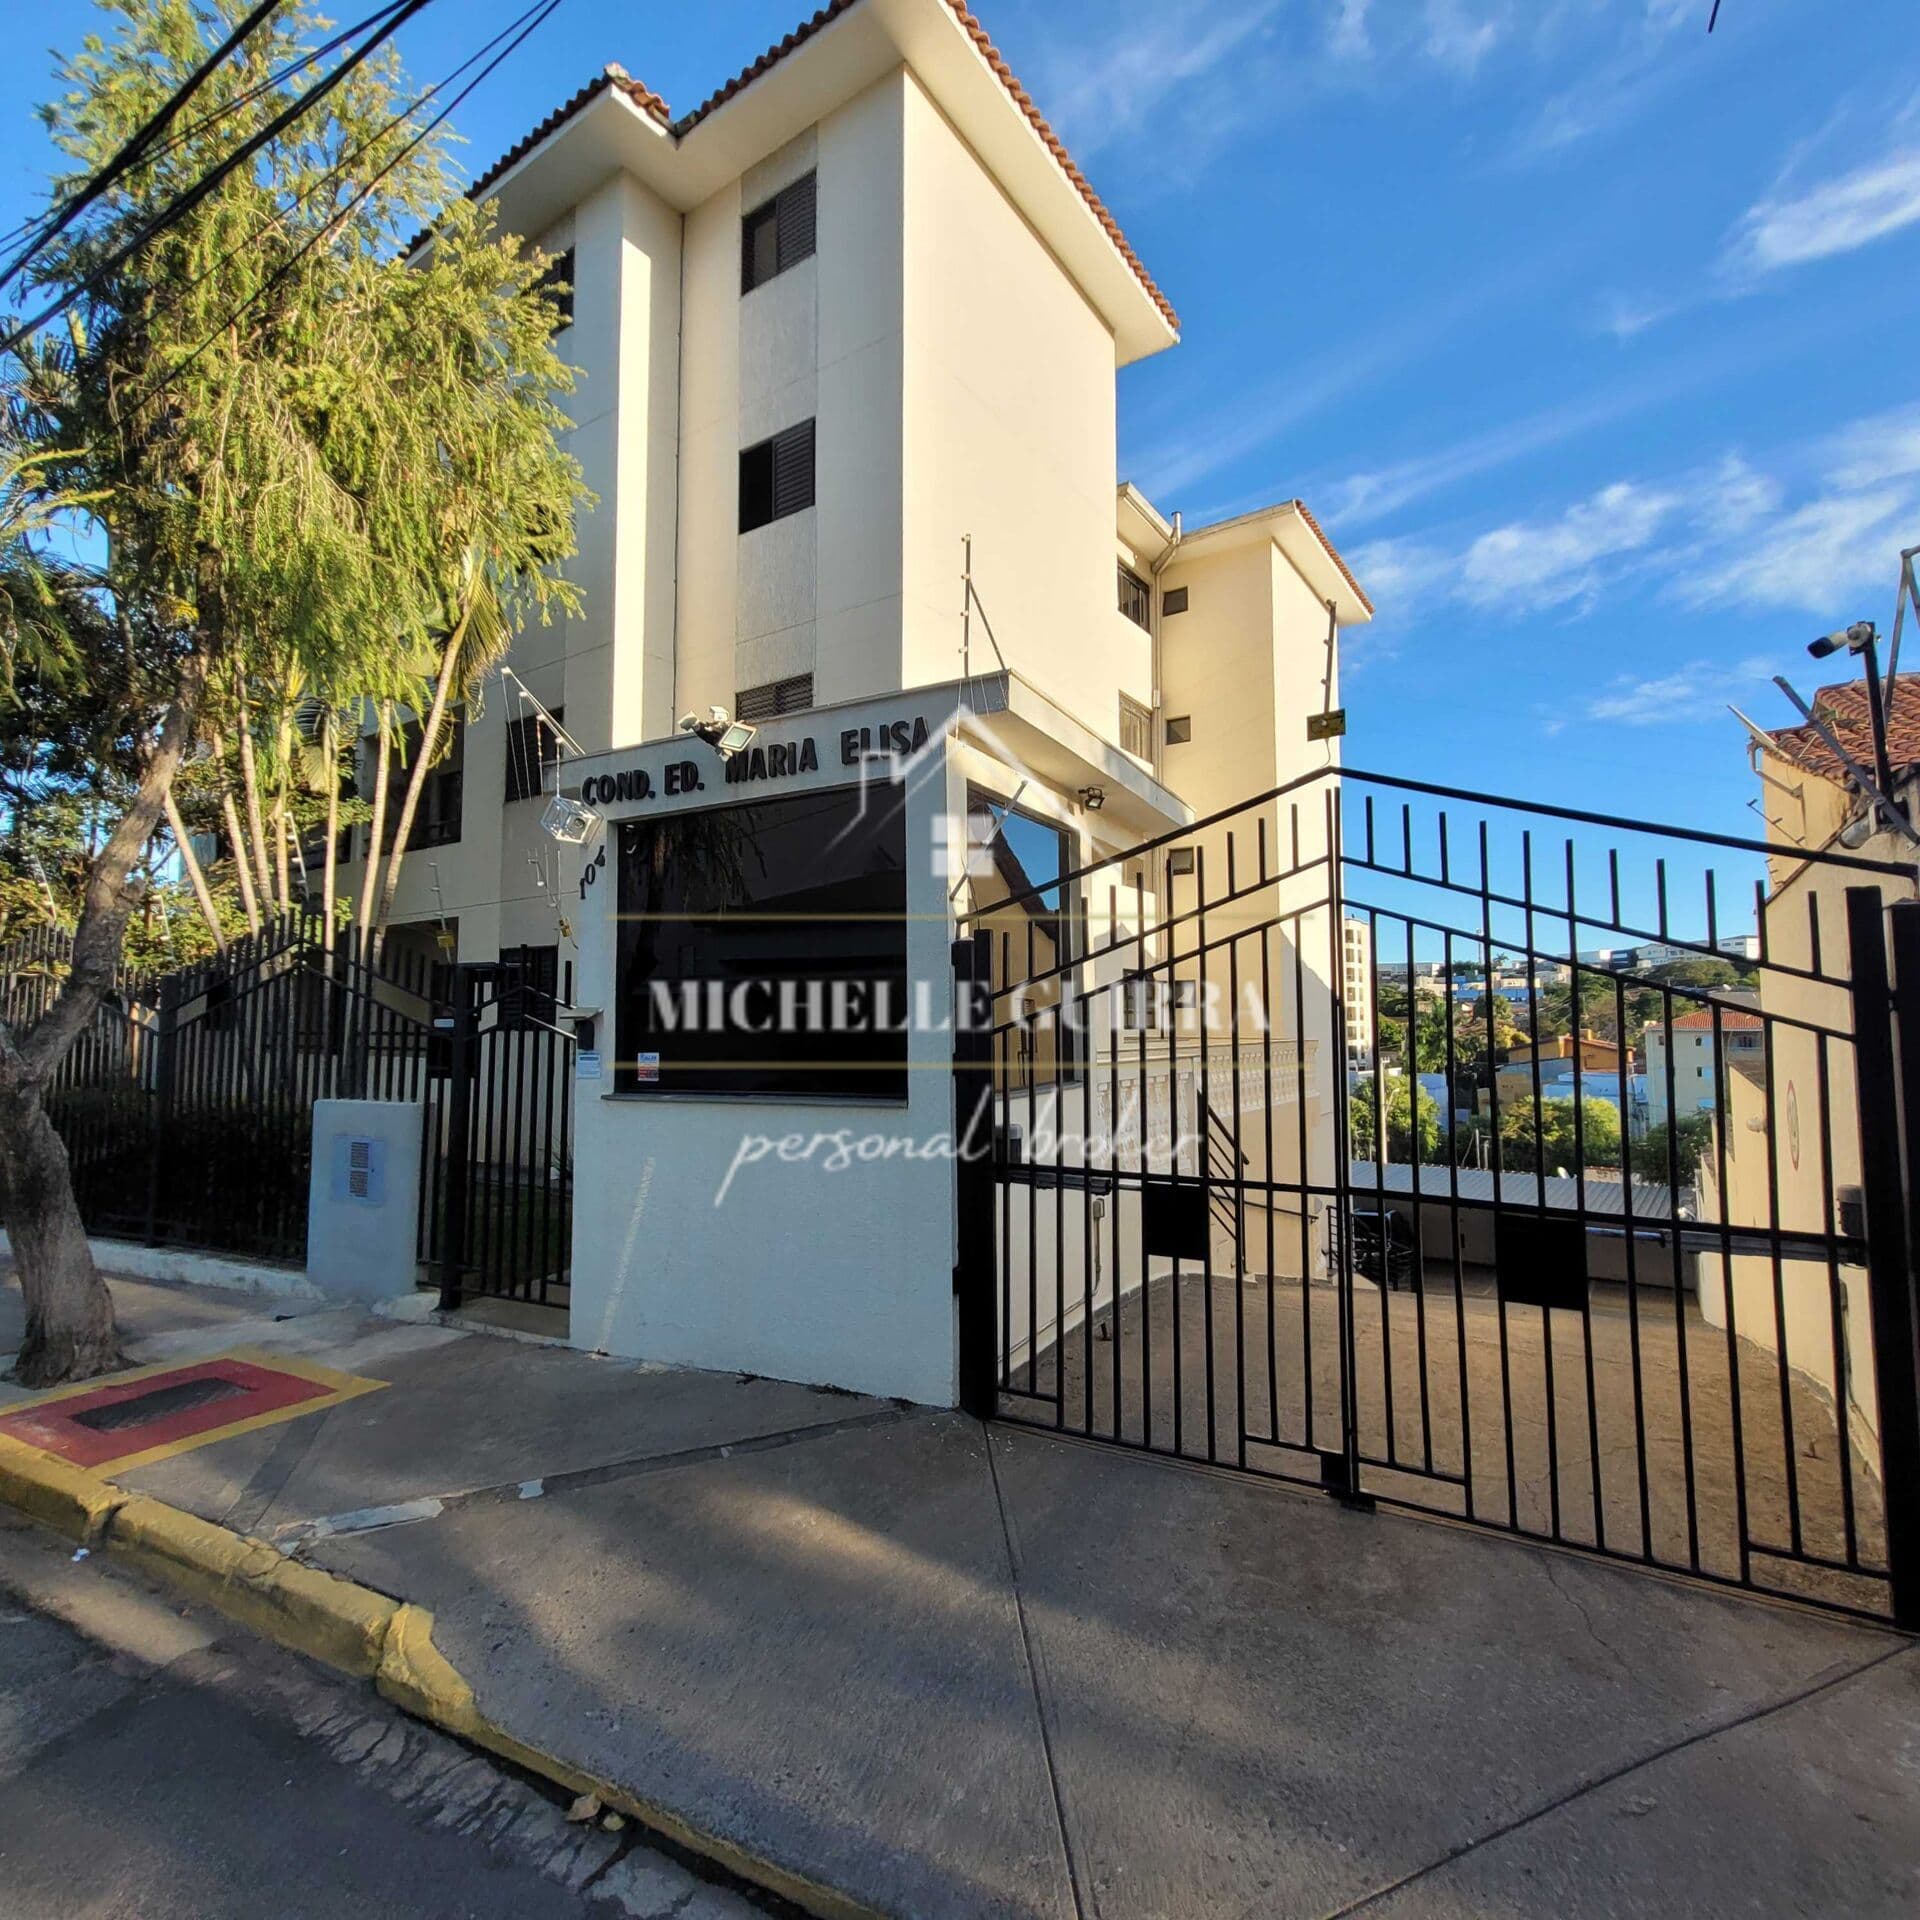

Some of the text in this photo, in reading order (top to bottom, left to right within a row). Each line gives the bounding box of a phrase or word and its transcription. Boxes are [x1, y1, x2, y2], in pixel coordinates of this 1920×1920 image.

[582, 717, 931, 806] COND. ED. MARIA ELISA
[579, 844, 606, 900] 104
